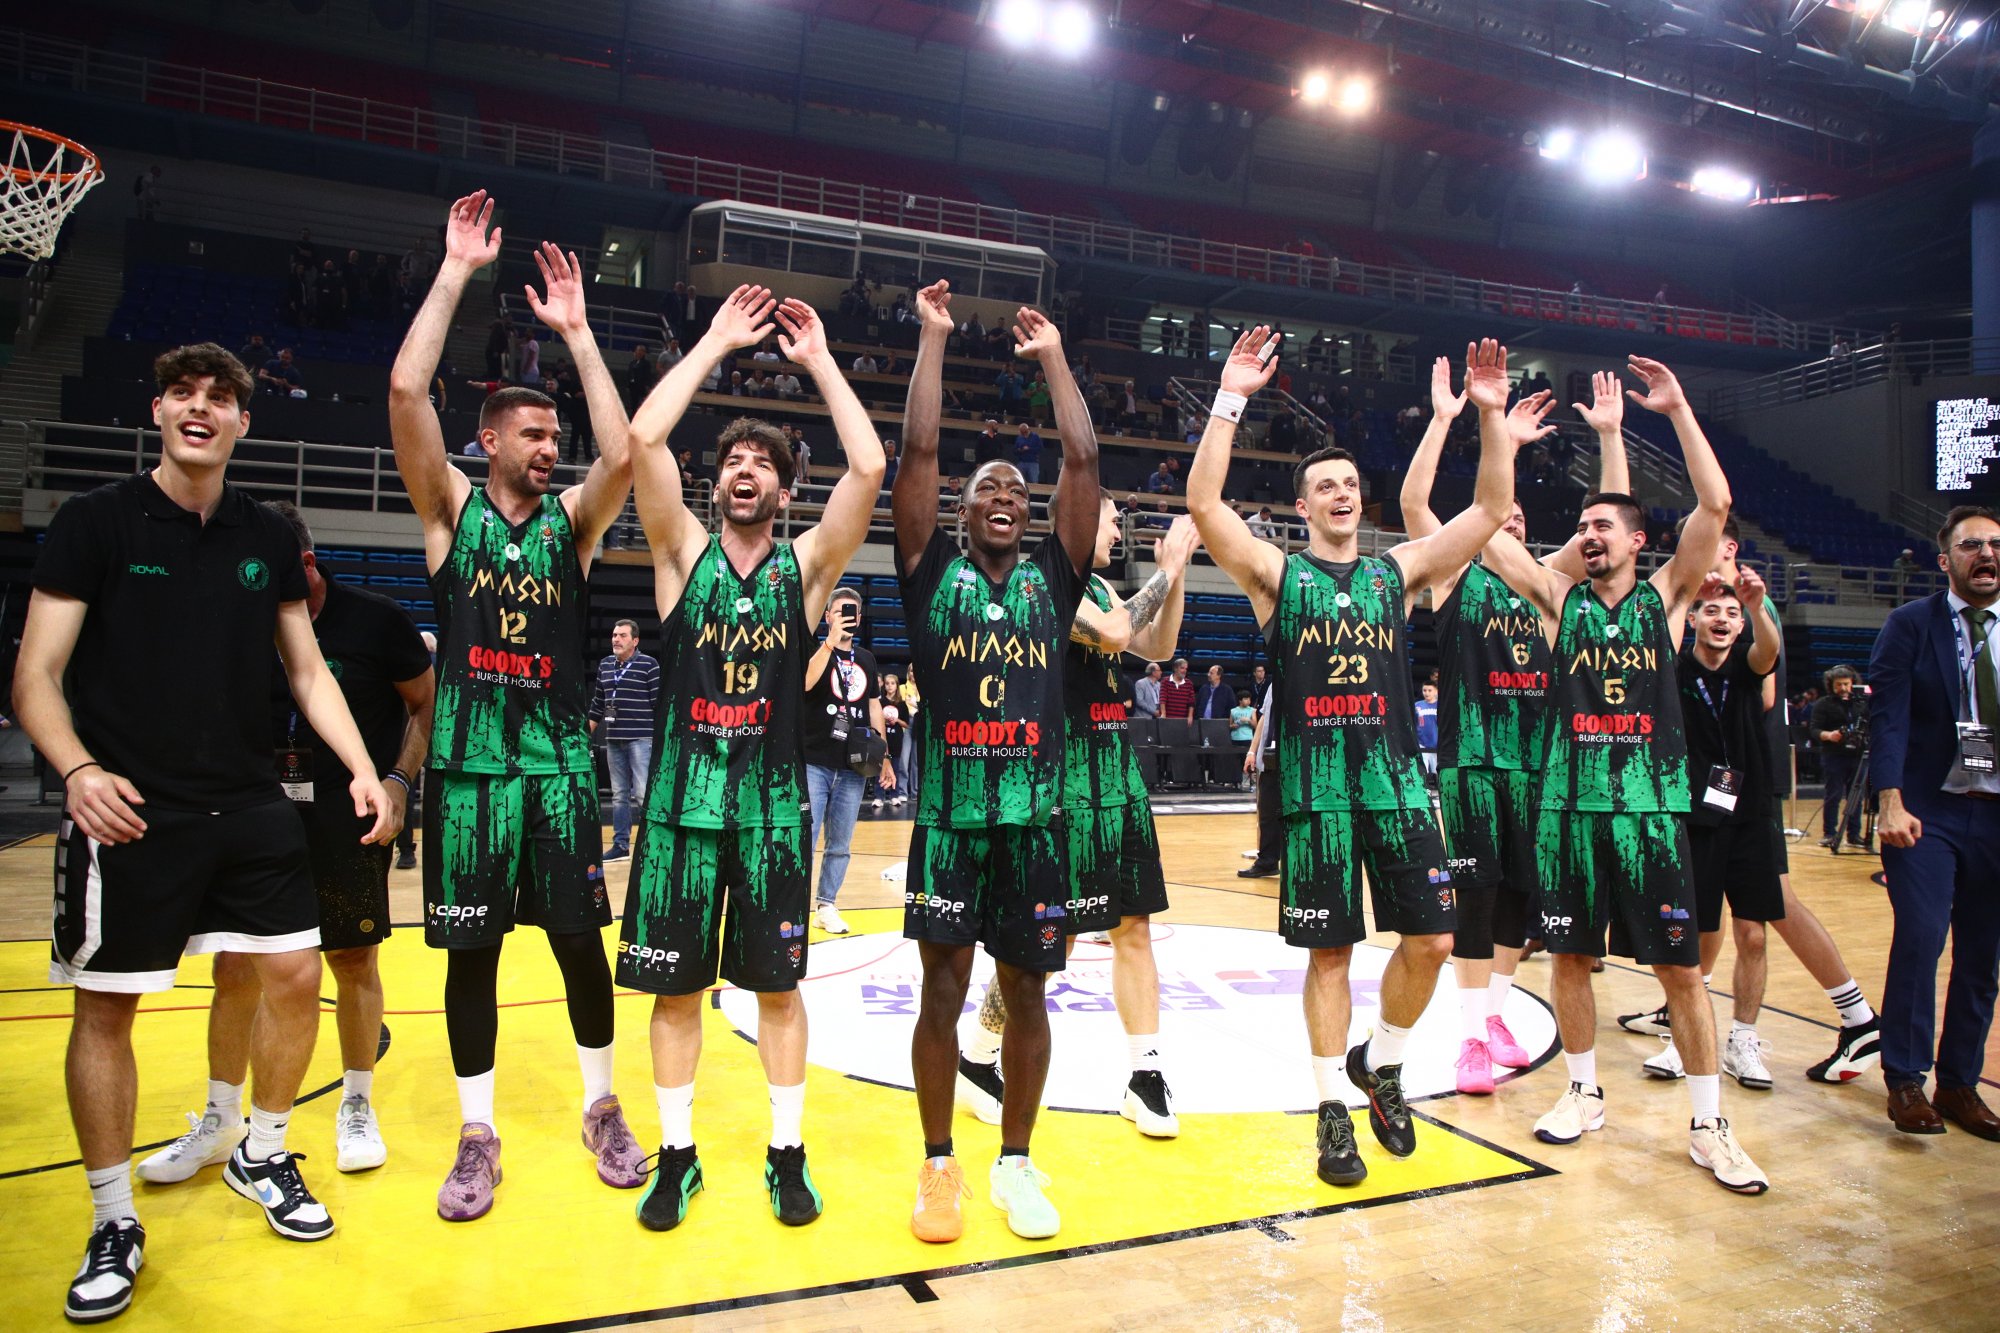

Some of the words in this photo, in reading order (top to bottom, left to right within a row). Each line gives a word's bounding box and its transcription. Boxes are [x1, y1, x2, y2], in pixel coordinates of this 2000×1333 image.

[129, 564, 170, 576] ROYAL
[468, 568, 561, 608] ΜΛΩΝ
[500, 607, 527, 644] 12
[1512, 643, 1530, 666] 6
[723, 661, 759, 694] 19
[1327, 654, 1369, 685] 23
[476, 671, 508, 685] BURGER
[511, 677, 542, 689] HOUSE
[1107, 668, 1118, 694] 4
[1494, 688, 1522, 697] BURGER
[1524, 688, 1545, 697] HOUSE
[1604, 678, 1626, 705] 5
[697, 723, 733, 738] BURGER
[735, 725, 765, 737] HOUS
[1312, 717, 1347, 727] BURGER
[1350, 716, 1381, 725] HOUSE
[1578, 733, 1614, 743] BURGER
[1617, 734, 1643, 744] HOUSE
[951, 747, 988, 757] BURGER
[992, 747, 1028, 757] HOUSE
[905, 892, 964, 914] esape
[1066, 906, 1108, 917] TALS
[1041, 923, 1057, 934] ELITE
